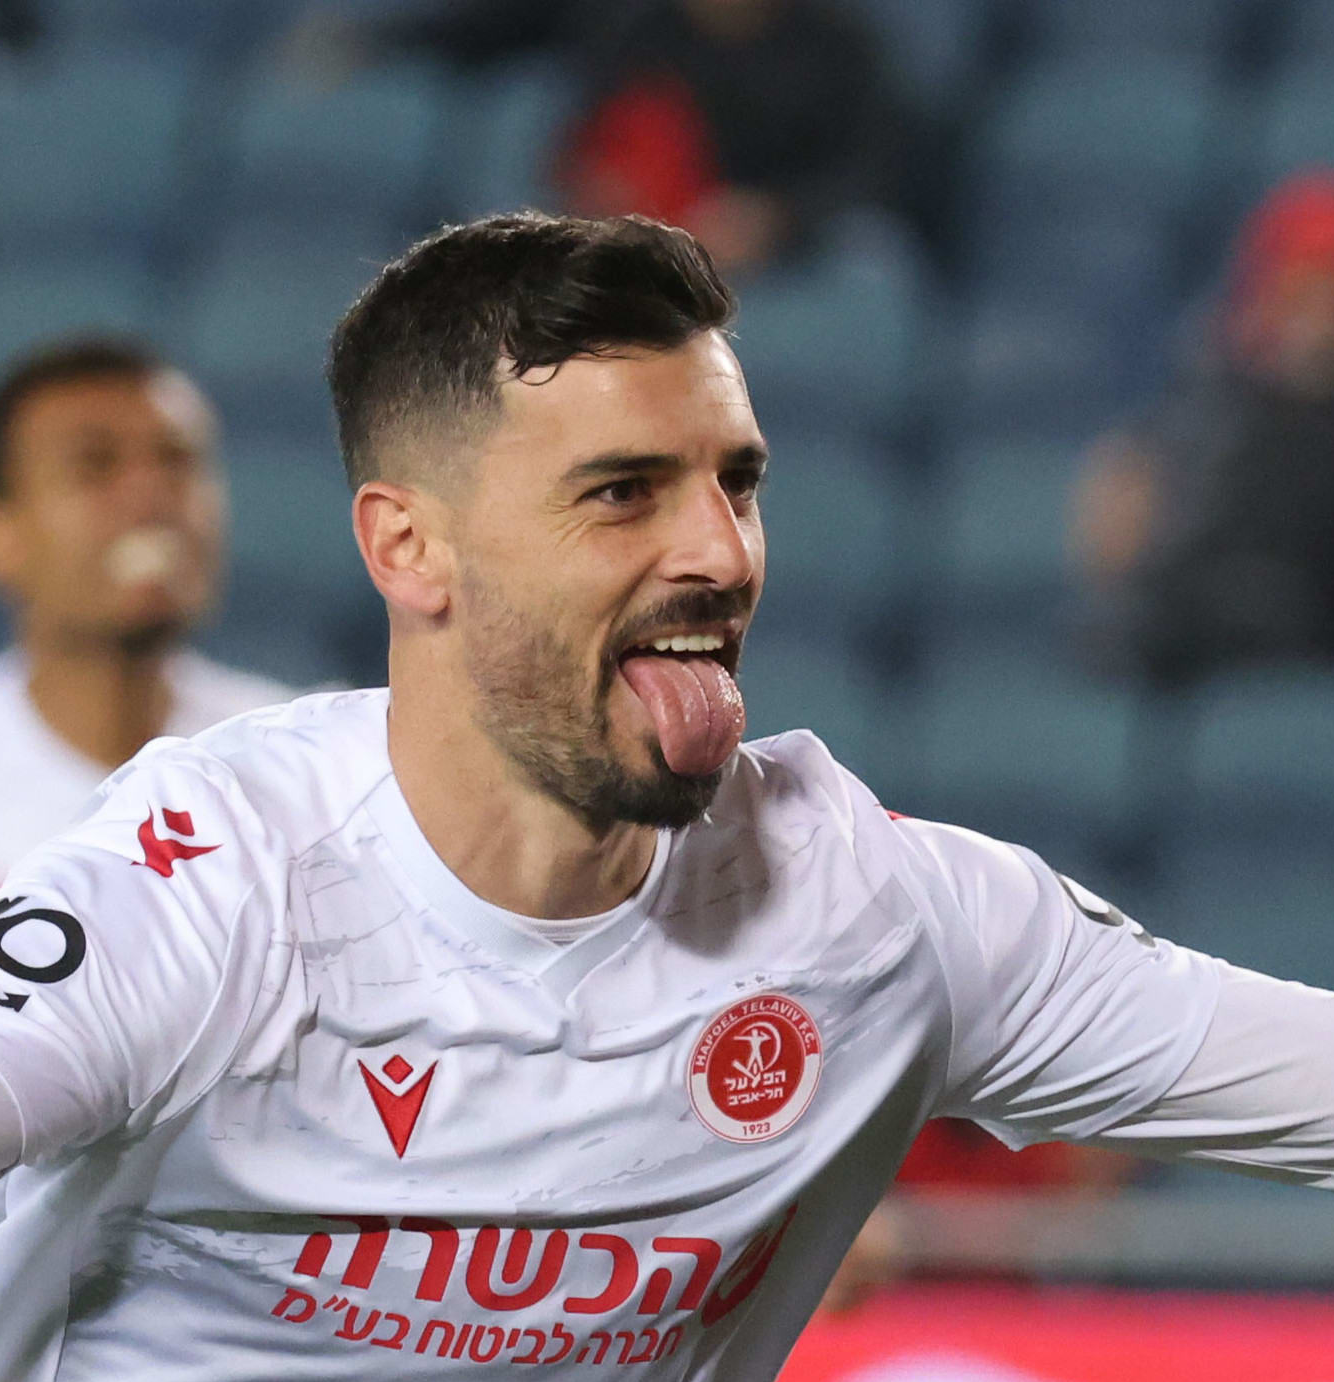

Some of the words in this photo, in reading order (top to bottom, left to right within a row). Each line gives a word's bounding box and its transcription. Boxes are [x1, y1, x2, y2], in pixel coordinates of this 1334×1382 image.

[695, 1012, 738, 1067] HAPOEL
[742, 1001, 801, 1023] TEL-AVIV
[798, 1022, 815, 1048] F.C.
[742, 1123, 771, 1136] 1923
[293, 1215, 723, 1315] הכשרה
[416, 1320, 575, 1364] לביטוח
[578, 1326, 681, 1365] חברה
